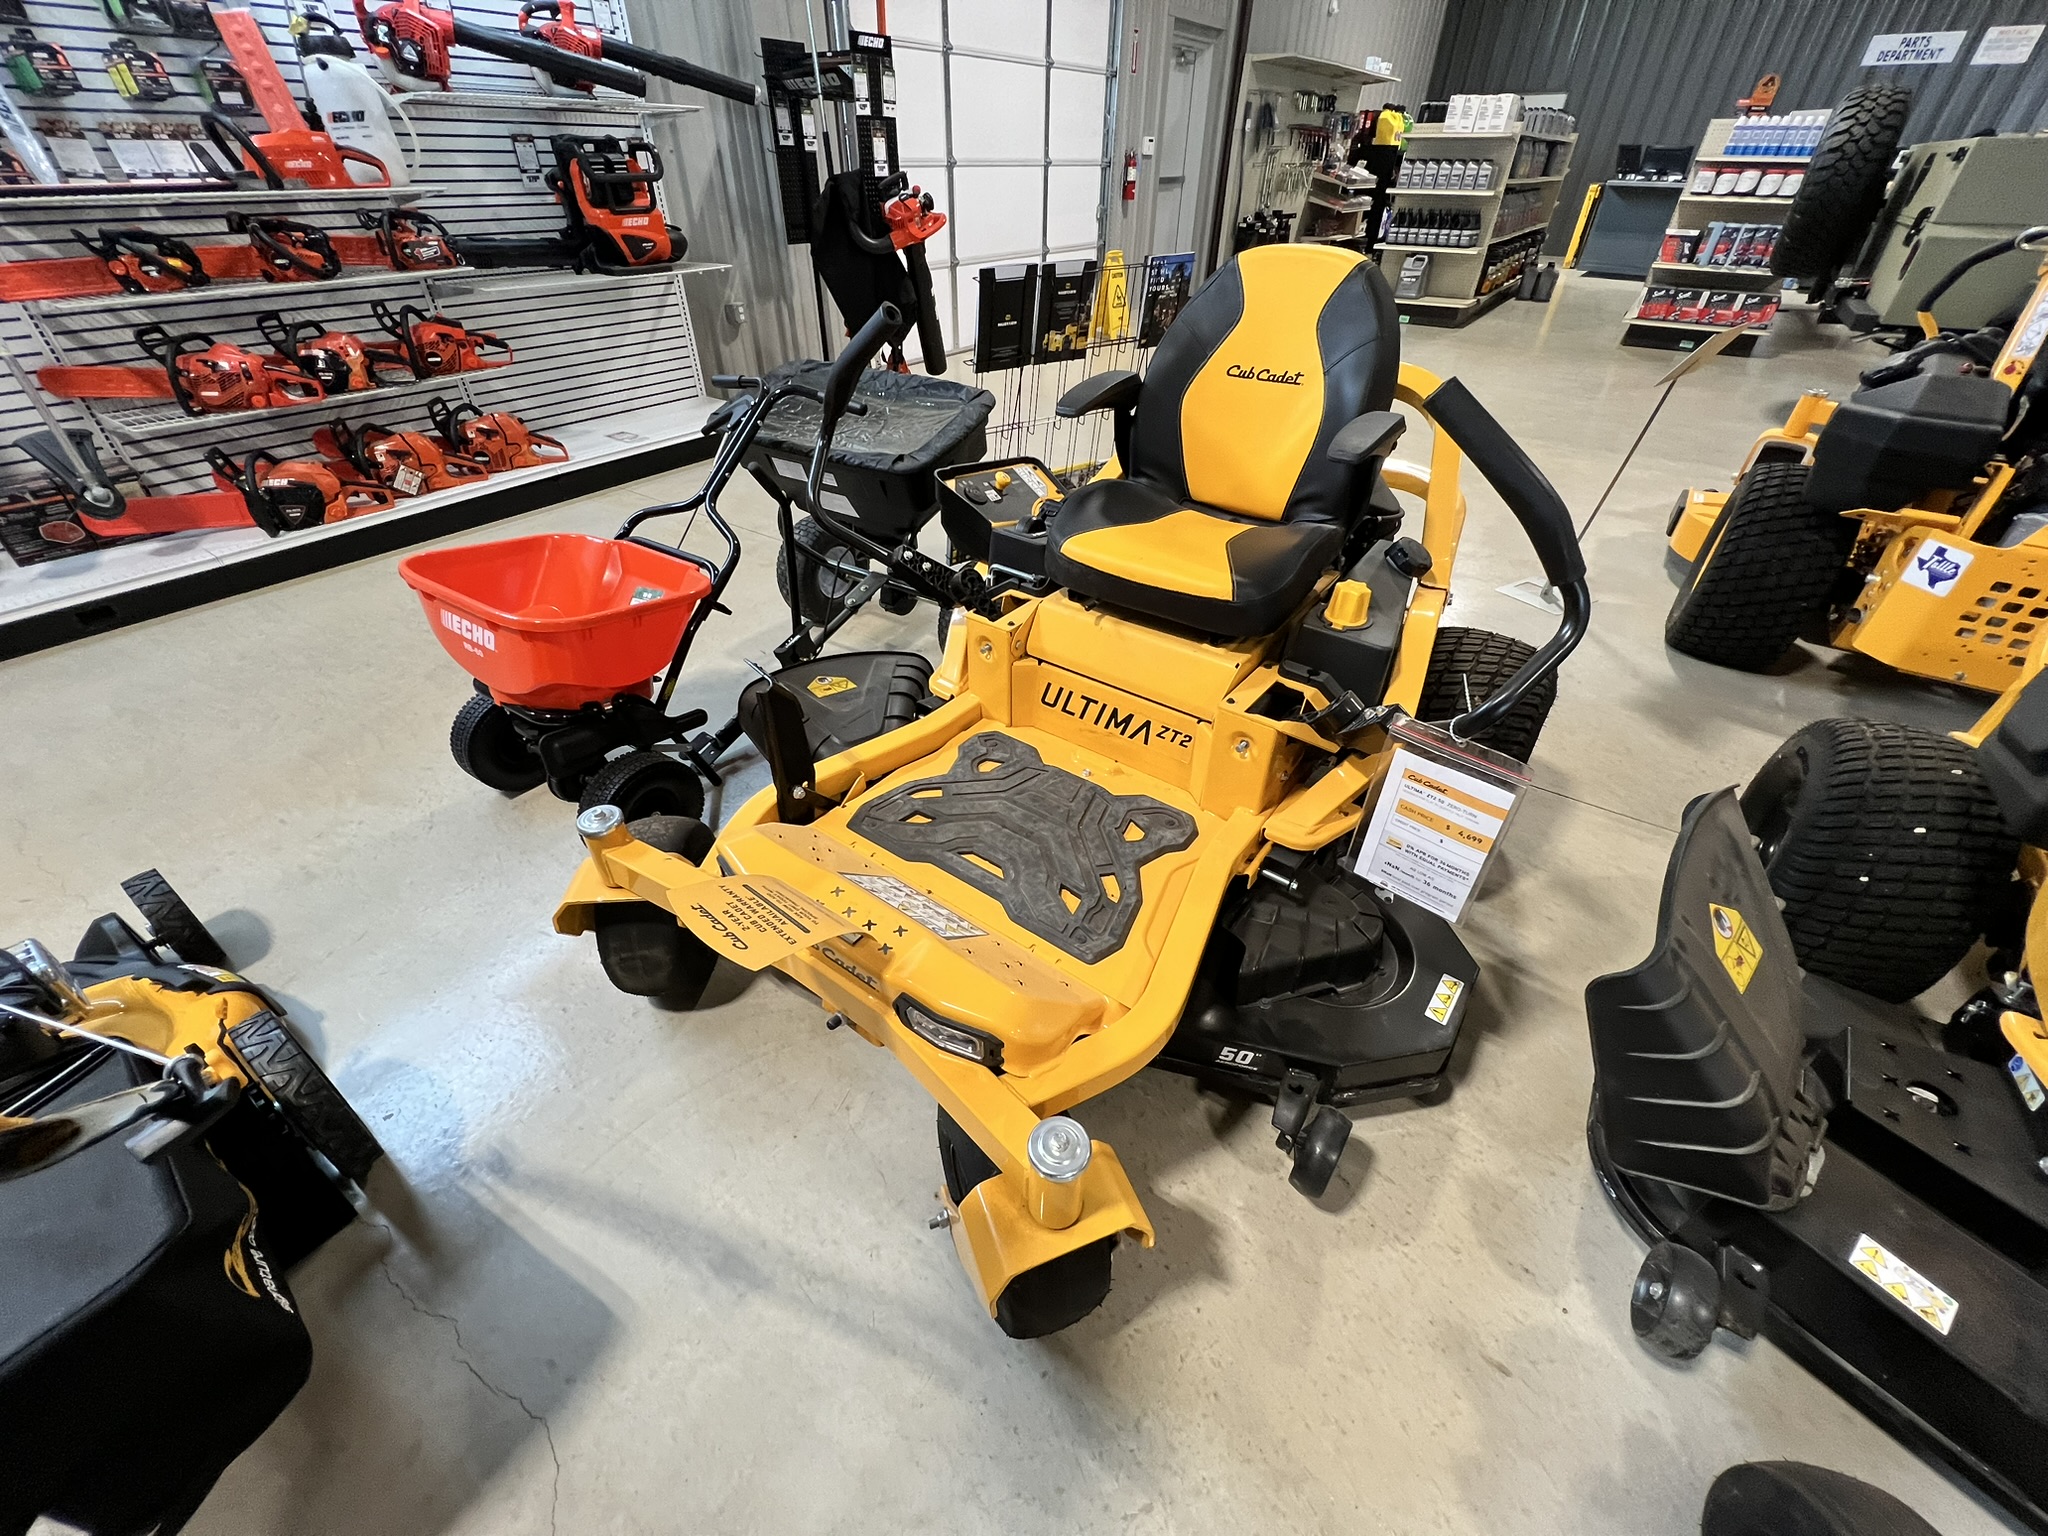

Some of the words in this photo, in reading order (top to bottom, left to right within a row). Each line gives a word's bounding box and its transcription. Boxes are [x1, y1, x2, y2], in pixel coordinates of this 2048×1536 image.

[864, 35, 885, 49] ECHO
[1899, 36, 1933, 49] PARTS
[1876, 47, 1944, 63] DEPARTMENT
[627, 217, 648, 226] ECHO
[1226, 364, 1255, 379] Cub
[1256, 368, 1304, 385] Cadet
[451, 613, 496, 652] ECHO
[1040, 682, 1152, 746] ULTIMA
[1156, 725, 1193, 749] ZT2
[1407, 773, 1423, 784] Cub
[1422, 779, 1448, 795] Cadet
[1399, 804, 1417, 814] CASH
[1416, 811, 1434, 822] PRICE
[1456, 829, 1483, 846] 4,699
[718, 885, 761, 915] WARRANTY
[1431, 884, 1457, 899] months
[690, 903, 728, 932] Cadet
[722, 909, 750, 931] 2-YEAR
[726, 901, 752, 920] CADET
[757, 913, 797, 946] EXTENDED
[722, 931, 749, 950] Cub
[822, 947, 878, 991] Cadet
[1218, 1046, 1263, 1065] 50"
